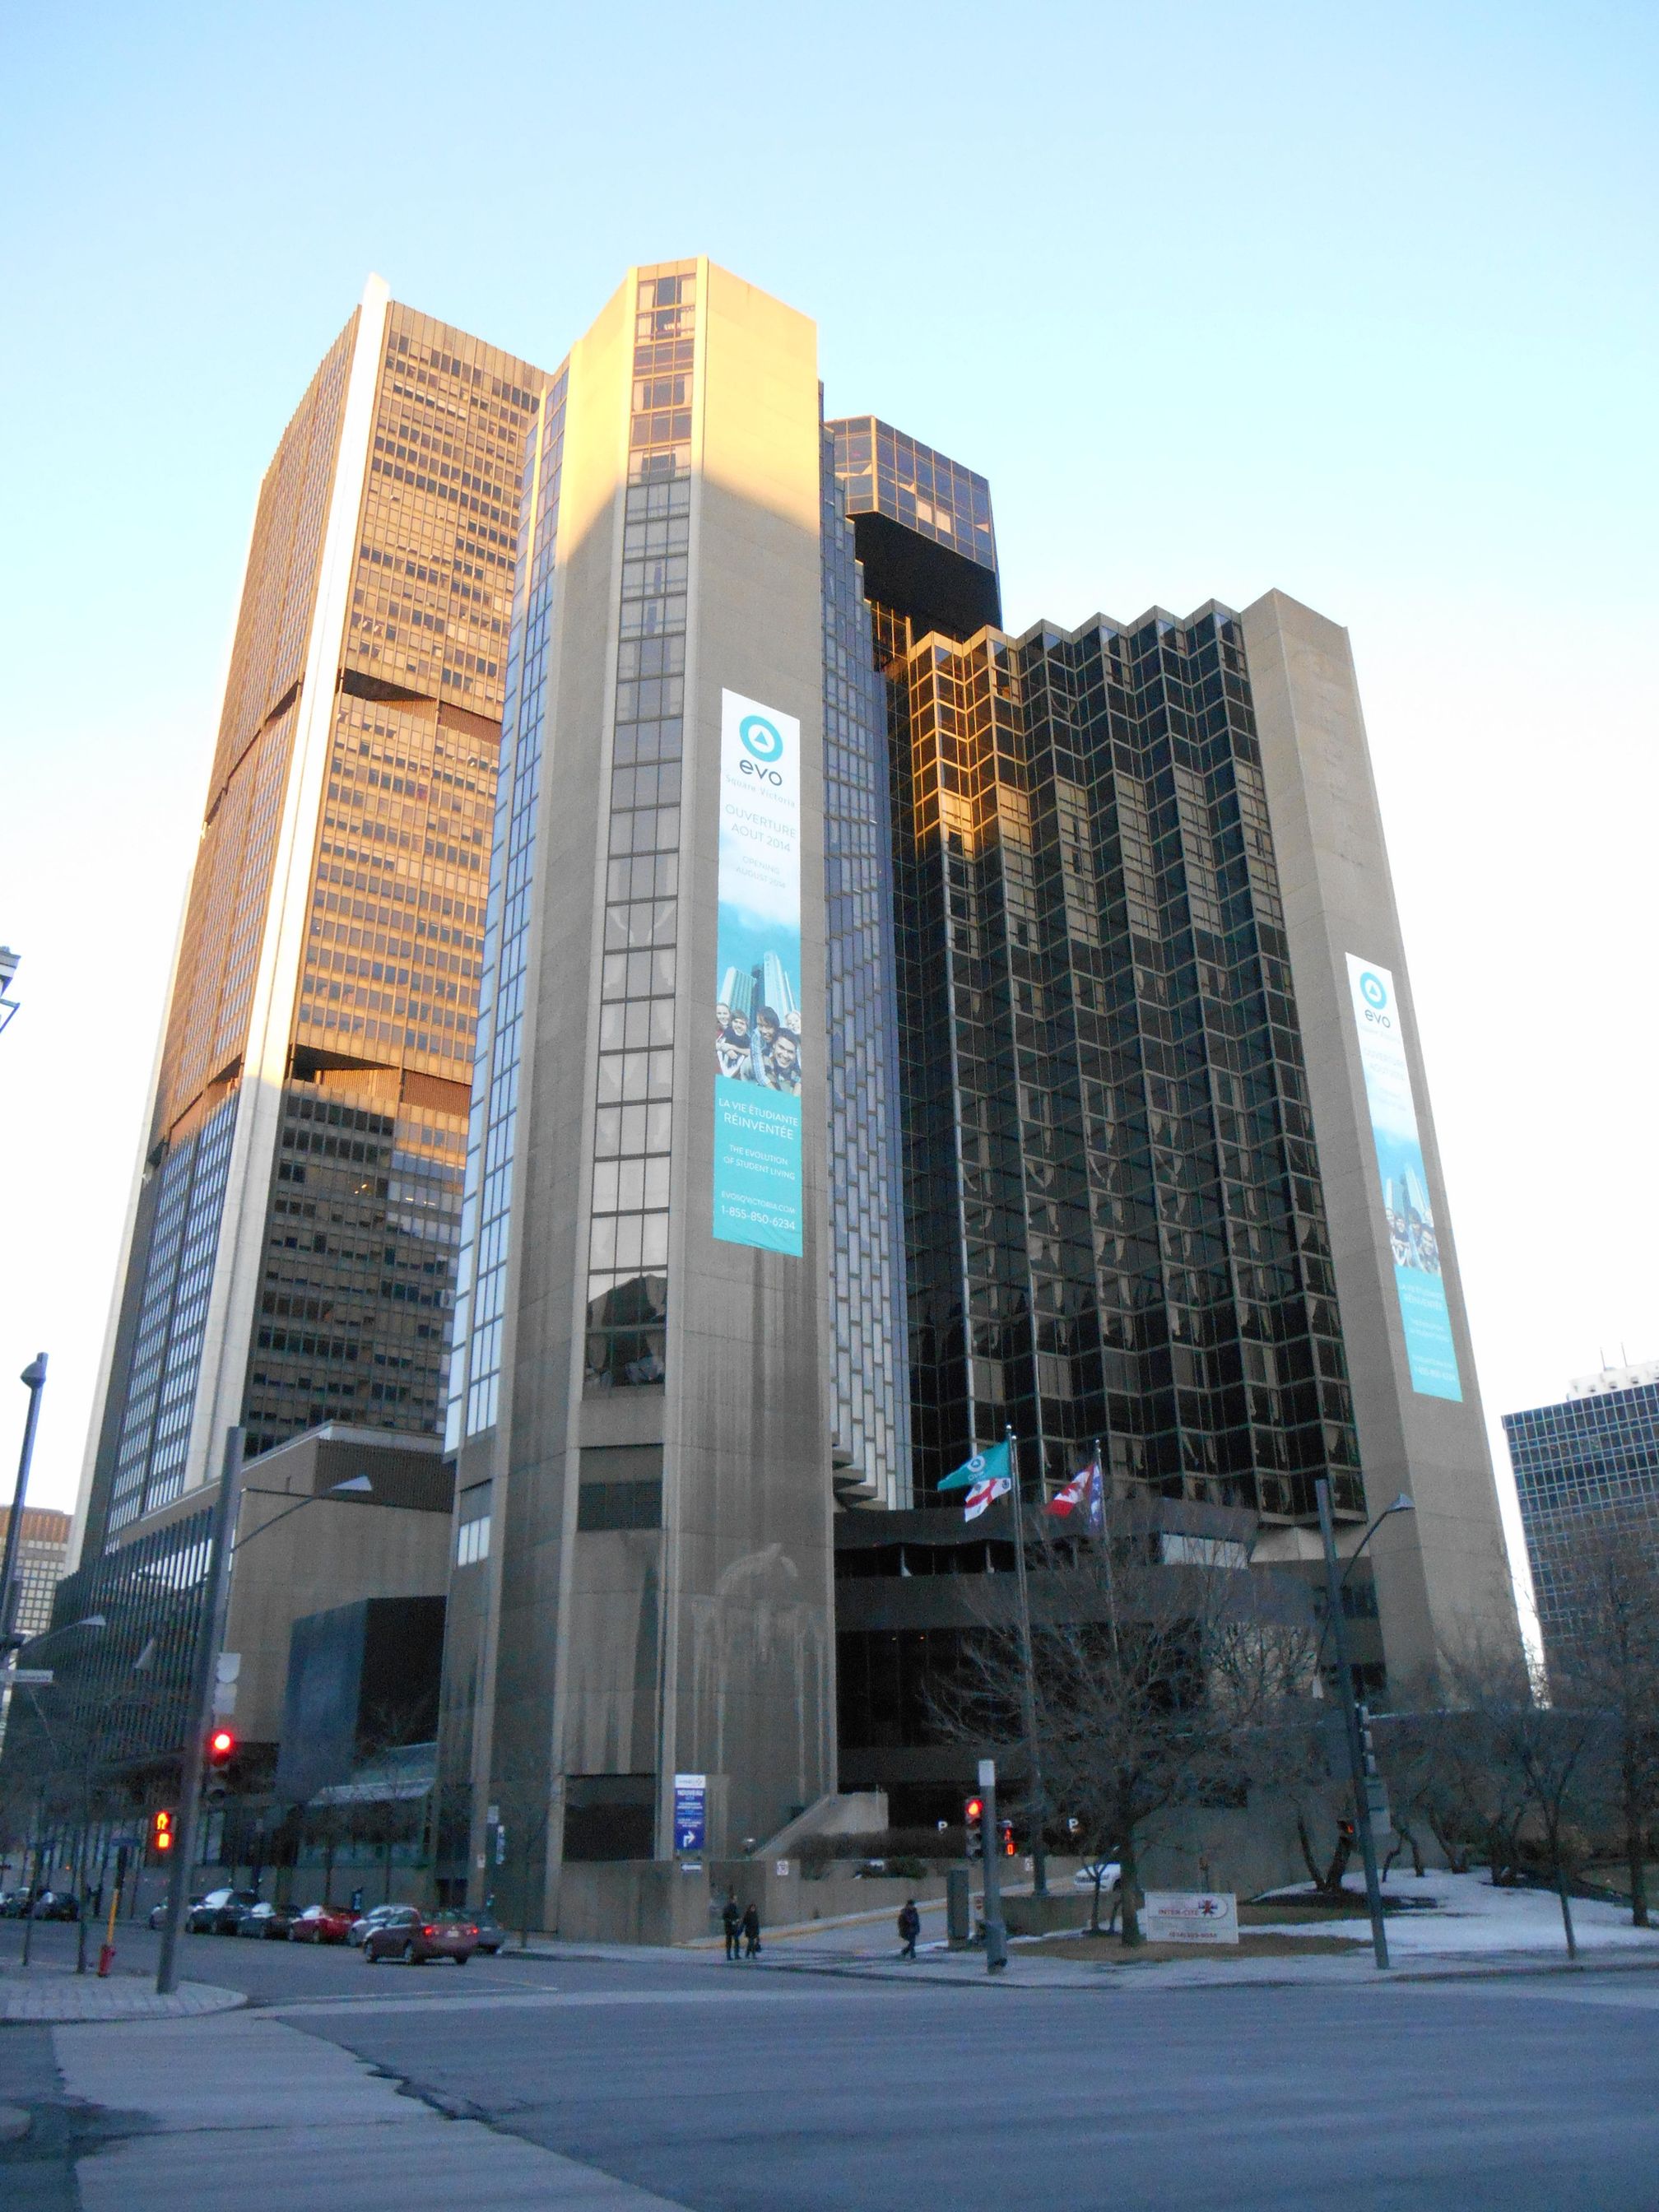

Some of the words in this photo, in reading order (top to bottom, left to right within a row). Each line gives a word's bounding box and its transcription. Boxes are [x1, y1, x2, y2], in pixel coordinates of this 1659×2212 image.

[740, 760, 783, 787] evo
[725, 774, 756, 792] Square
[760, 788, 796, 807] Victoria
[725, 803, 797, 839] OUVERTURE
[766, 835, 791, 852] 2014
[742, 856, 780, 875] OPENING
[1364, 1009, 1391, 1029] evo
[718, 1098, 731, 1108] LA
[732, 1101, 746, 1113] VIE
[749, 1104, 798, 1127] ÉTUDIANTE
[724, 1112, 793, 1140] RÉINVENTÉE
[730, 1145, 744, 1155] THE
[745, 1149, 788, 1165] EVOLUTION
[724, 1156, 735, 1164] OF
[736, 1159, 769, 1173] STUDENT
[770, 1168, 795, 1180] LIVING
[722, 1205, 795, 1230] 1-855-850-6234
[938, 1820, 948, 1832] P
